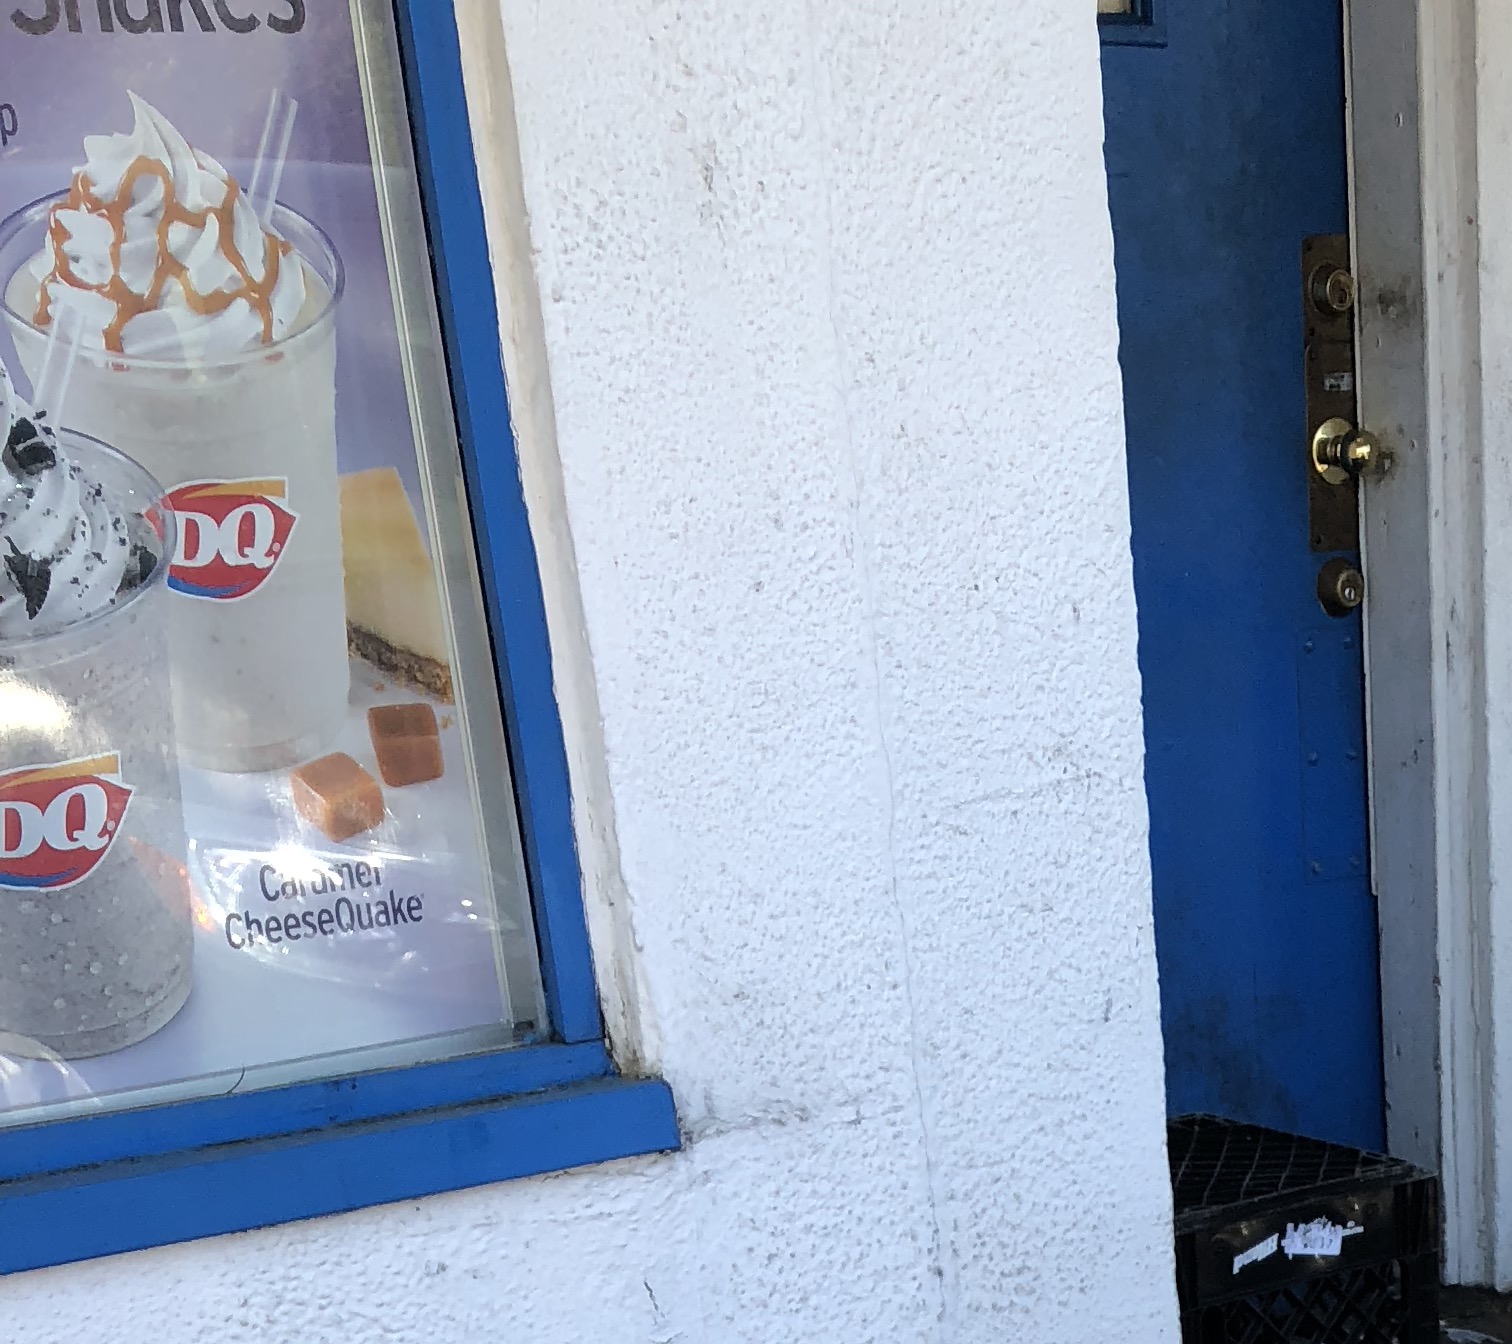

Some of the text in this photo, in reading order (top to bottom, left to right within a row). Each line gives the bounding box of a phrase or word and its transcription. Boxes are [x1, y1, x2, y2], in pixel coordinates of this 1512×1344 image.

[170, 503, 275, 569] DQ
[0, 783, 109, 859] DQ
[225, 890, 423, 949] CheeseQuake
